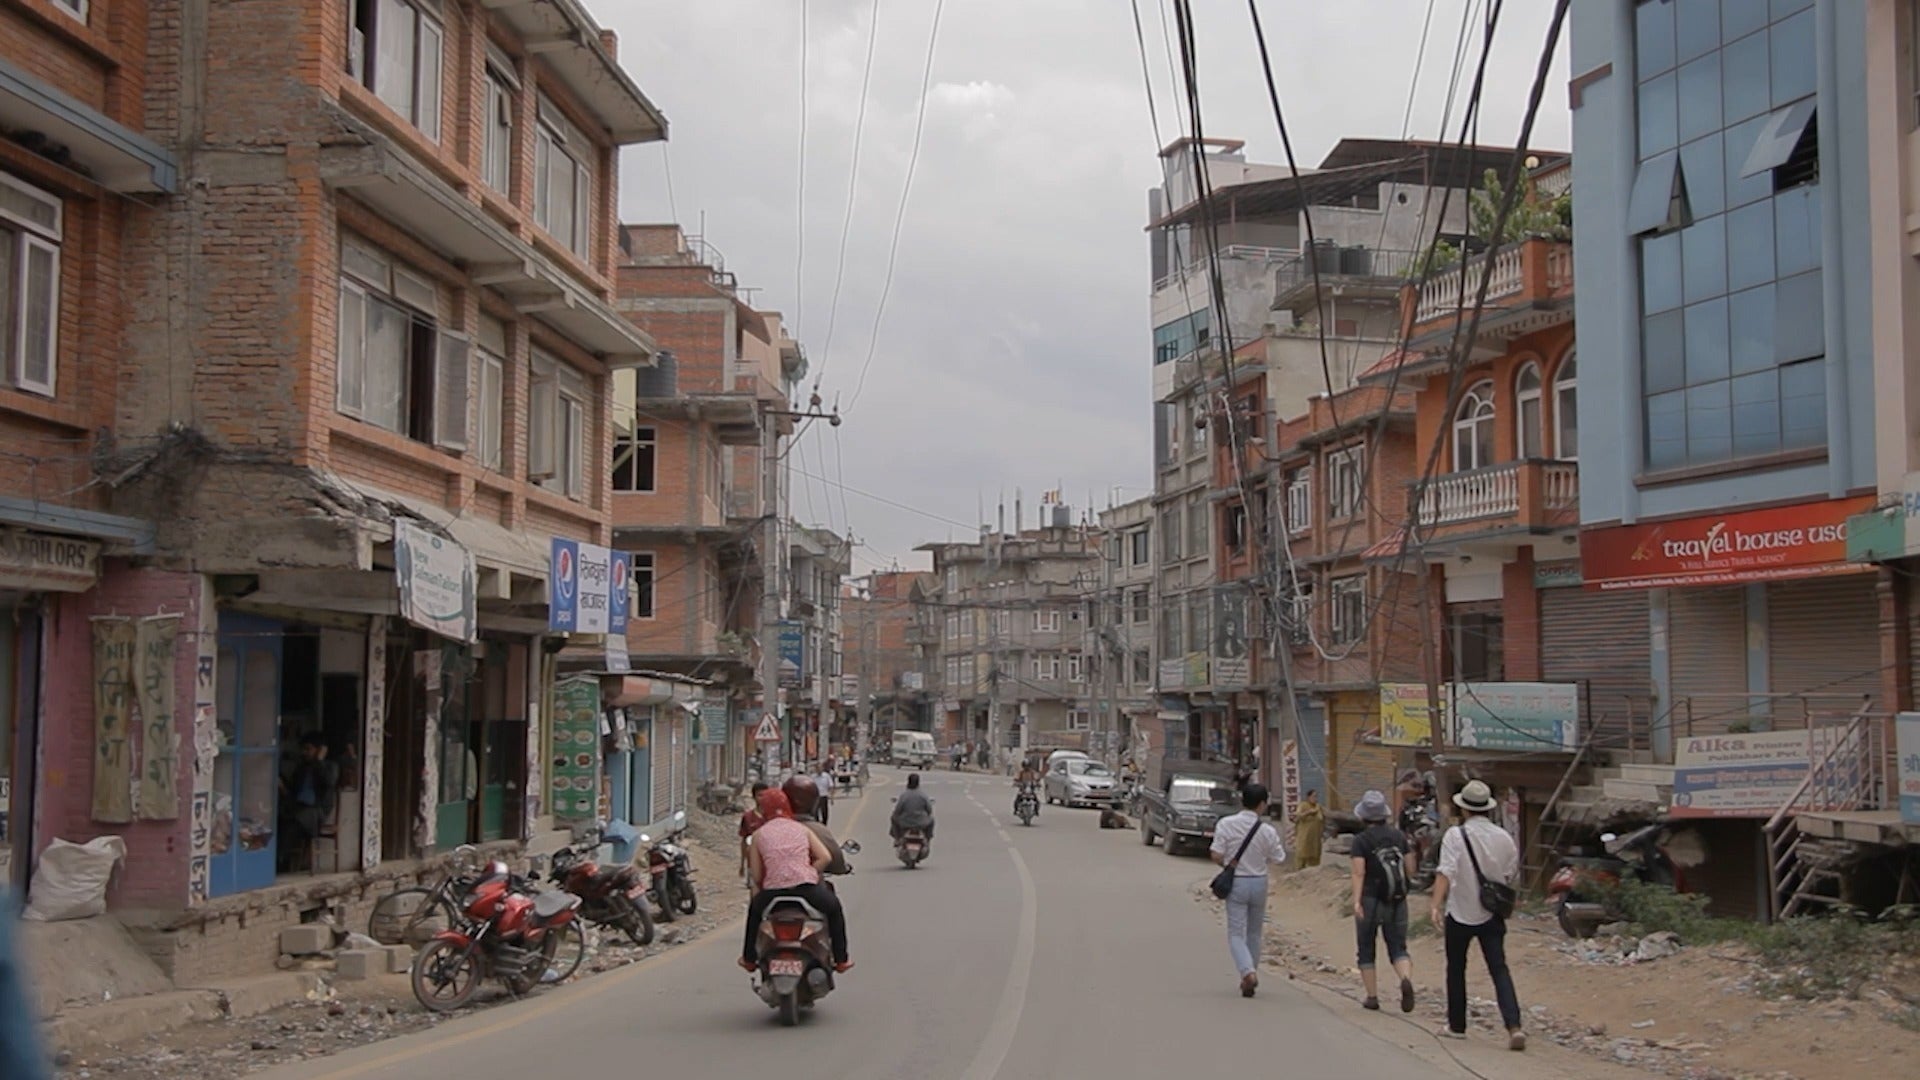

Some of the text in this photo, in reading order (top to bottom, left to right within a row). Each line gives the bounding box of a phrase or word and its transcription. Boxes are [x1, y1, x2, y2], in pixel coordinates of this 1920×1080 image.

[16, 537, 87, 568] TAILORS
[1663, 522, 1732, 561] travel
[1737, 529, 1803, 550] house
[1688, 738, 1746, 753] Alka
